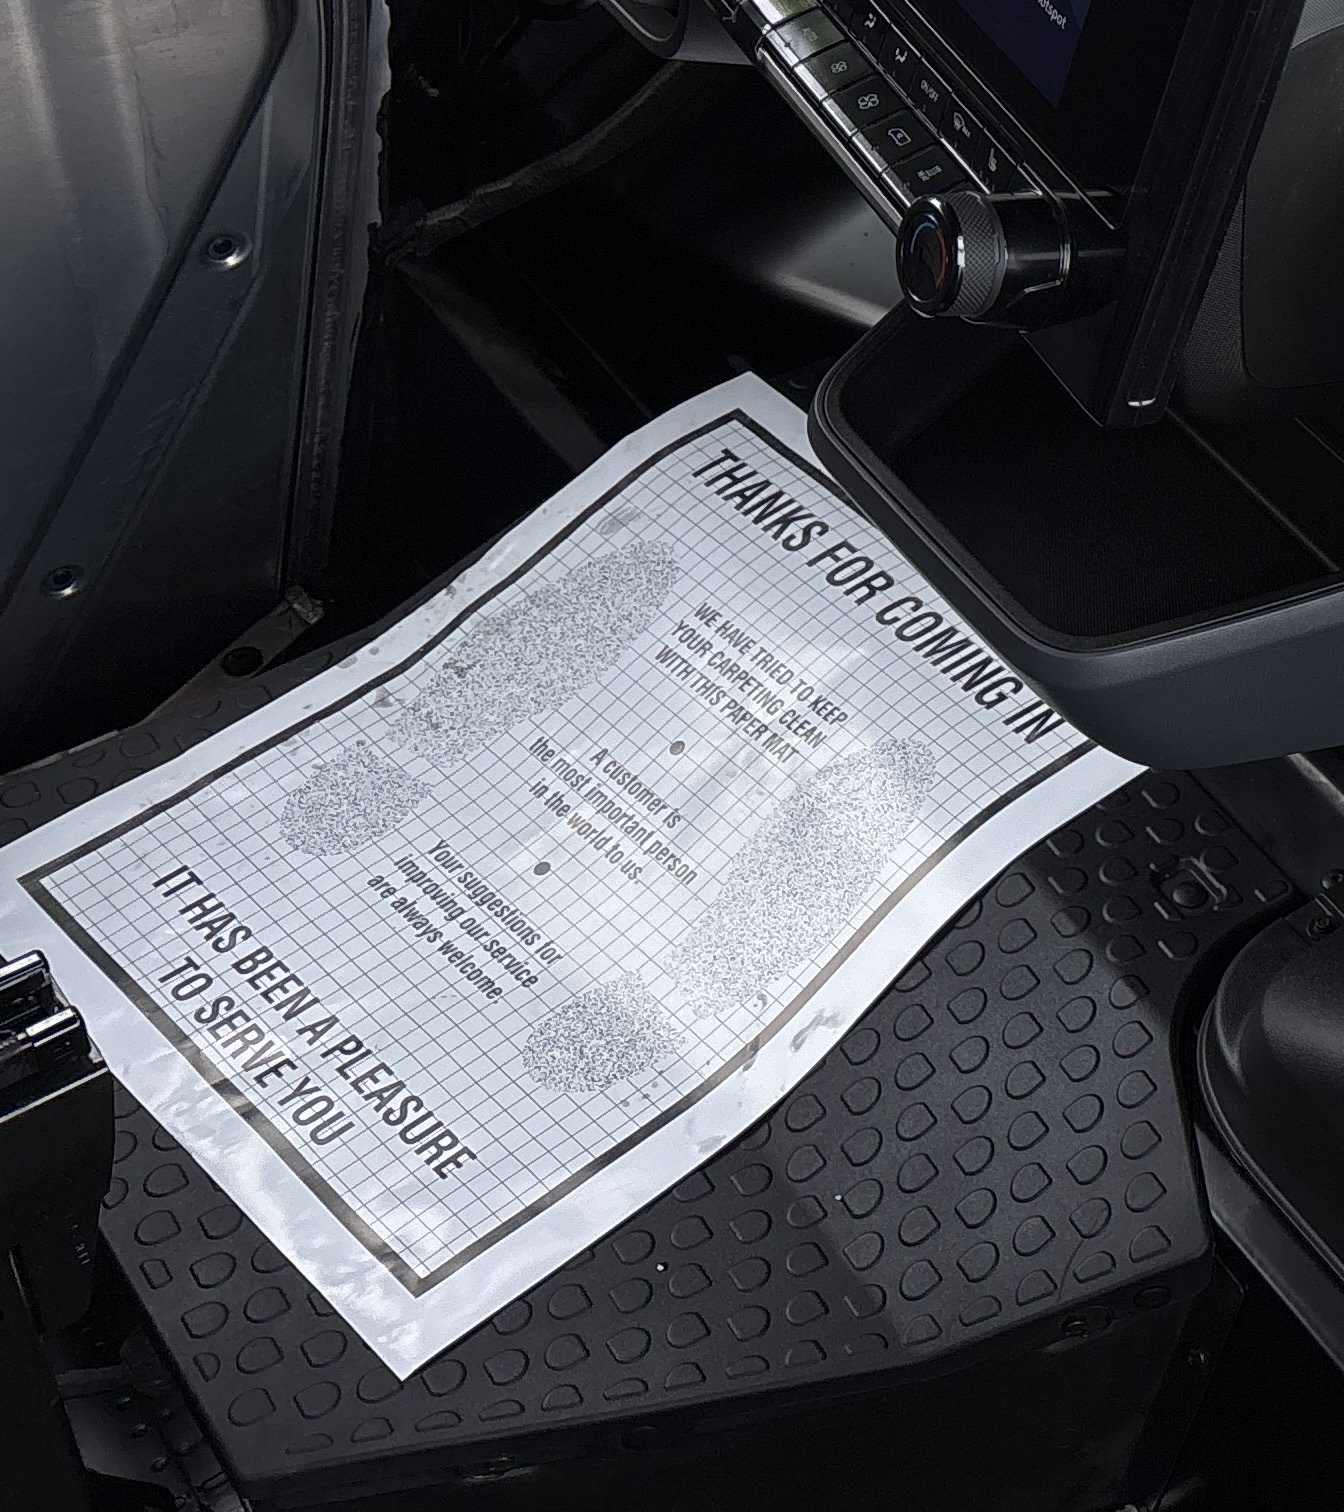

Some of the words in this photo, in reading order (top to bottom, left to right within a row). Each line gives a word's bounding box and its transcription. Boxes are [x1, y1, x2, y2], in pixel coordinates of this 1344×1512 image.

[691, 447, 829, 552] THANKS
[806, 538, 896, 607] FOR
[875, 595, 1024, 710] COMING
[1002, 699, 1065, 746] IN
[654, 644, 697, 681] WITH
[690, 672, 727, 706] THIS
[719, 699, 769, 741] PAPER
[761, 733, 799, 763] MAT
[671, 619, 714, 658] YOUR
[707, 650, 785, 716] CARPETING
[779, 709, 827, 749] CLEAN
[694, 602, 723, 628] WE
[714, 620, 757, 656] HAVE
[750, 646, 794, 686] TRIED
[789, 678, 815, 702] TO
[807, 694, 849, 726] KEEP
[529, 736, 556, 762] the
[551, 757, 592, 792] most
[584, 782, 655, 847] important
[643, 839, 698, 886] person
[529, 777, 549, 799] in
[544, 791, 571, 817] the
[567, 812, 613, 851] world
[605, 843, 624, 864] to
[620, 860, 643, 885] us.
[589, 748, 608, 766] A
[602, 760, 668, 816] customer
[662, 808, 681, 828] is
[367, 875, 397, 899] are
[390, 896, 443, 943] always
[438, 940, 503, 1005] welcome.
[394, 853, 466, 922] improving
[459, 917, 491, 941] our
[482, 939, 539, 988] service
[428, 839, 465, 873] Your
[457, 871, 541, 946] suggestions
[534, 940, 564, 965] for
[152, 864, 204, 898] IT
[178, 892, 252, 953] HAS
[232, 945, 320, 1022] BEEN
[296, 1014, 340, 1047] A
[319, 1034, 477, 1180] PLEASURE
[158, 956, 214, 1002] TO
[193, 996, 297, 1089] SERVE
[277, 1076, 355, 1146] YOU
